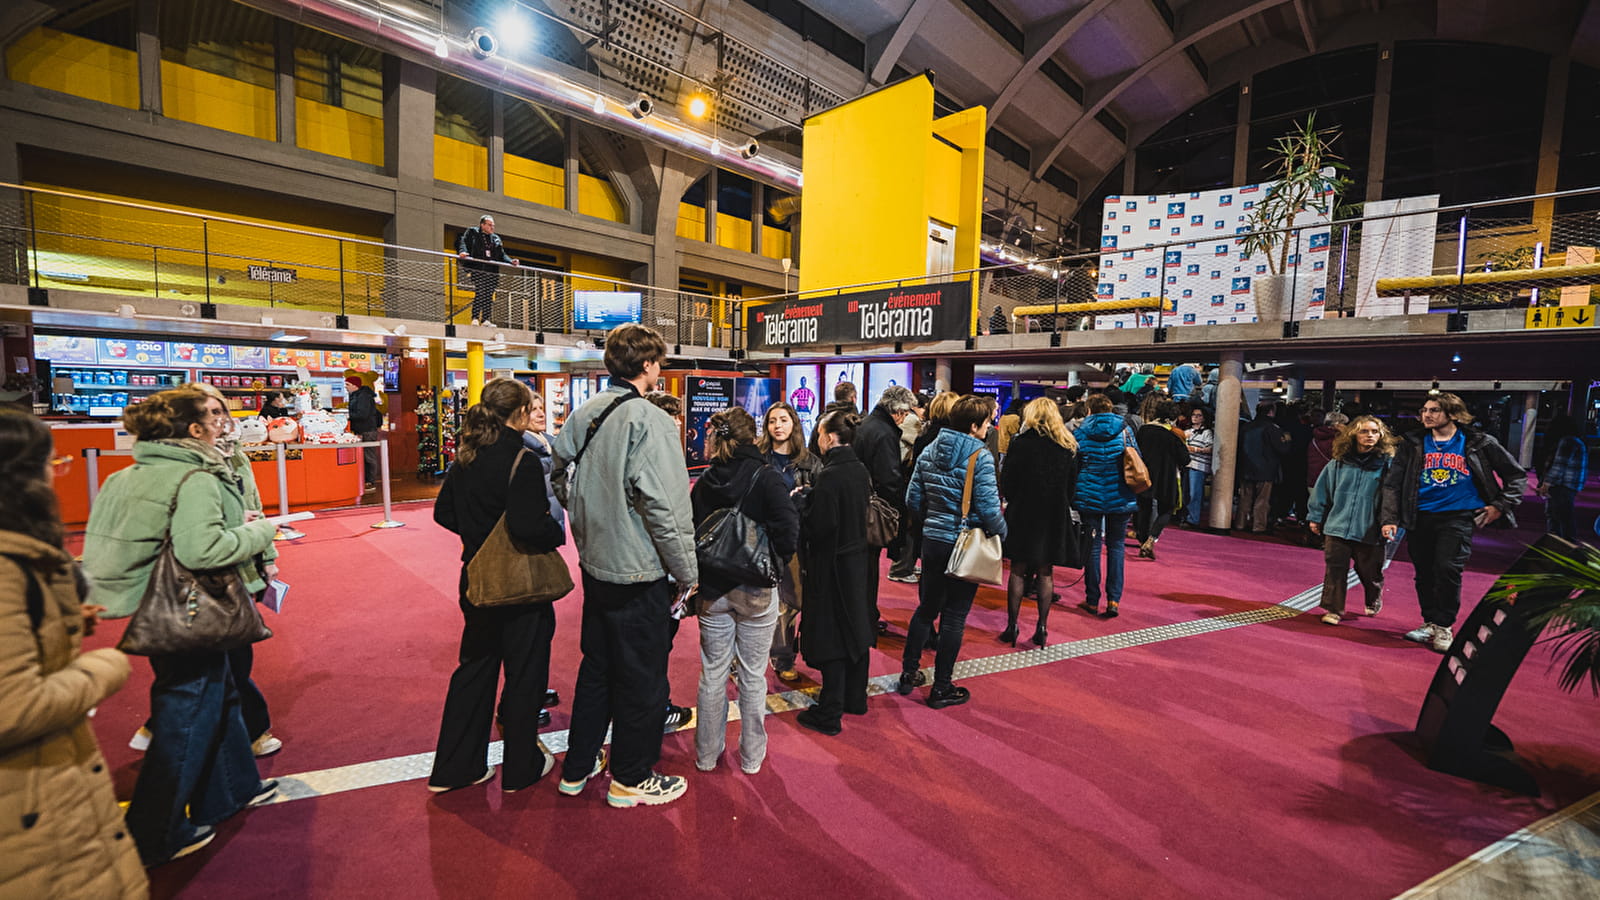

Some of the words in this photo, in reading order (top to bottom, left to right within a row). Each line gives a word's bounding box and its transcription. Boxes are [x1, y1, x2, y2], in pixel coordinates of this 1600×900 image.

[248, 265, 292, 283] Télérama
[848, 301, 858, 313] un
[887, 290, 942, 309] événement
[784, 303, 823, 320] événement
[763, 313, 818, 345] Télérama
[858, 302, 933, 339] Télérama
[135, 343, 162, 351] SOLO
[203, 346, 226, 355] DUO
[1424, 452, 1443, 469] RY
